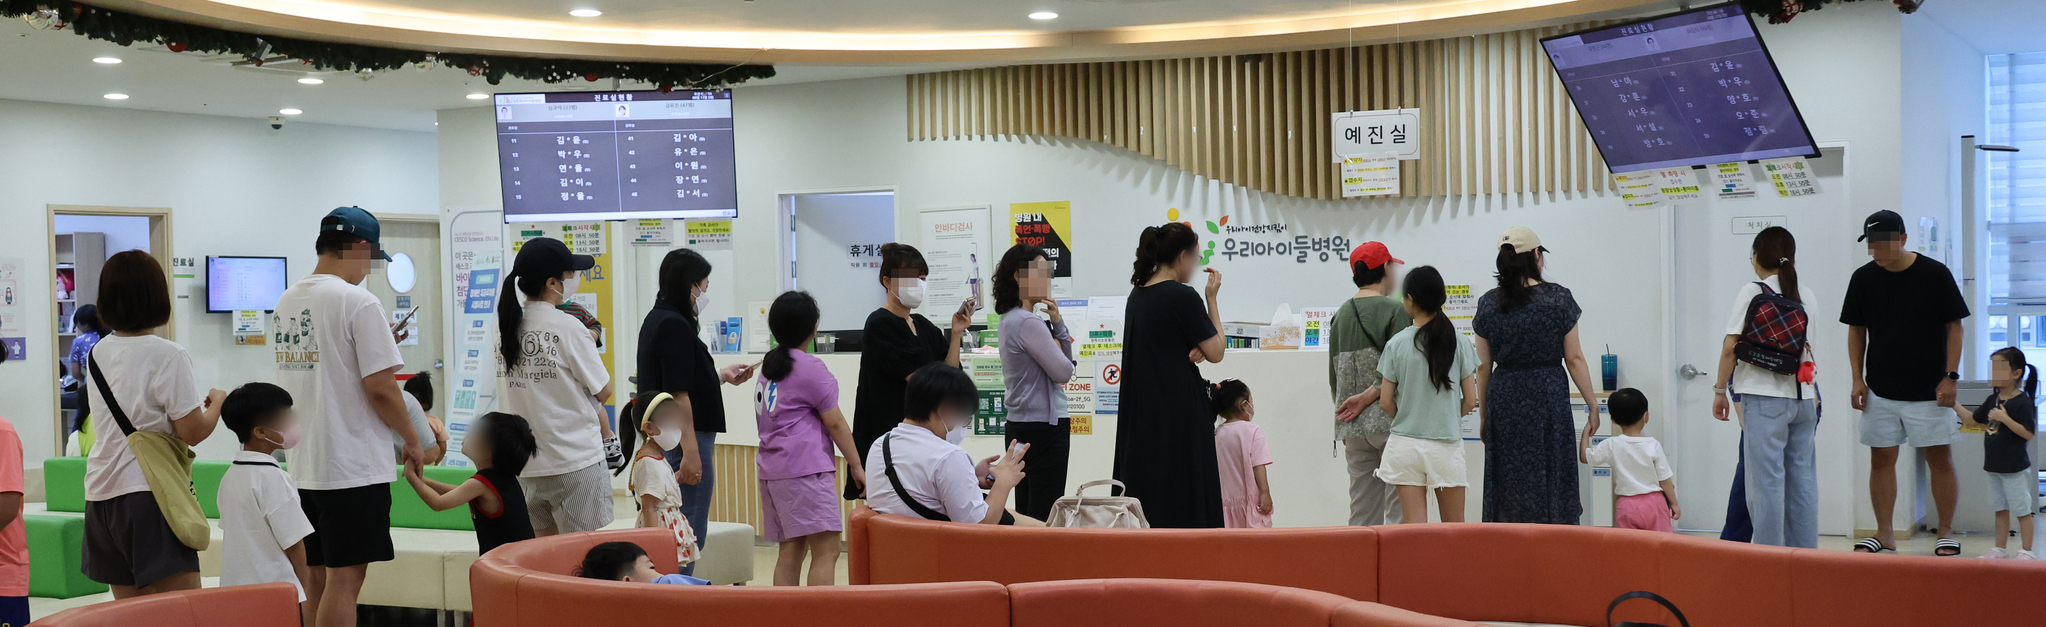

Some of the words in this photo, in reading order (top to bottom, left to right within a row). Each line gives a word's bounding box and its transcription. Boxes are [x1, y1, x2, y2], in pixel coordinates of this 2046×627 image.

[1344, 123, 1406, 145] 예진실
[1014, 212, 1031, 222] 병원
[1033, 212, 1042, 222] 내
[934, 222, 973, 233] 인바디검사
[1225, 223, 1287, 234] 우리아이건강지킴이
[1221, 235, 1350, 263] 우리아이들병원
